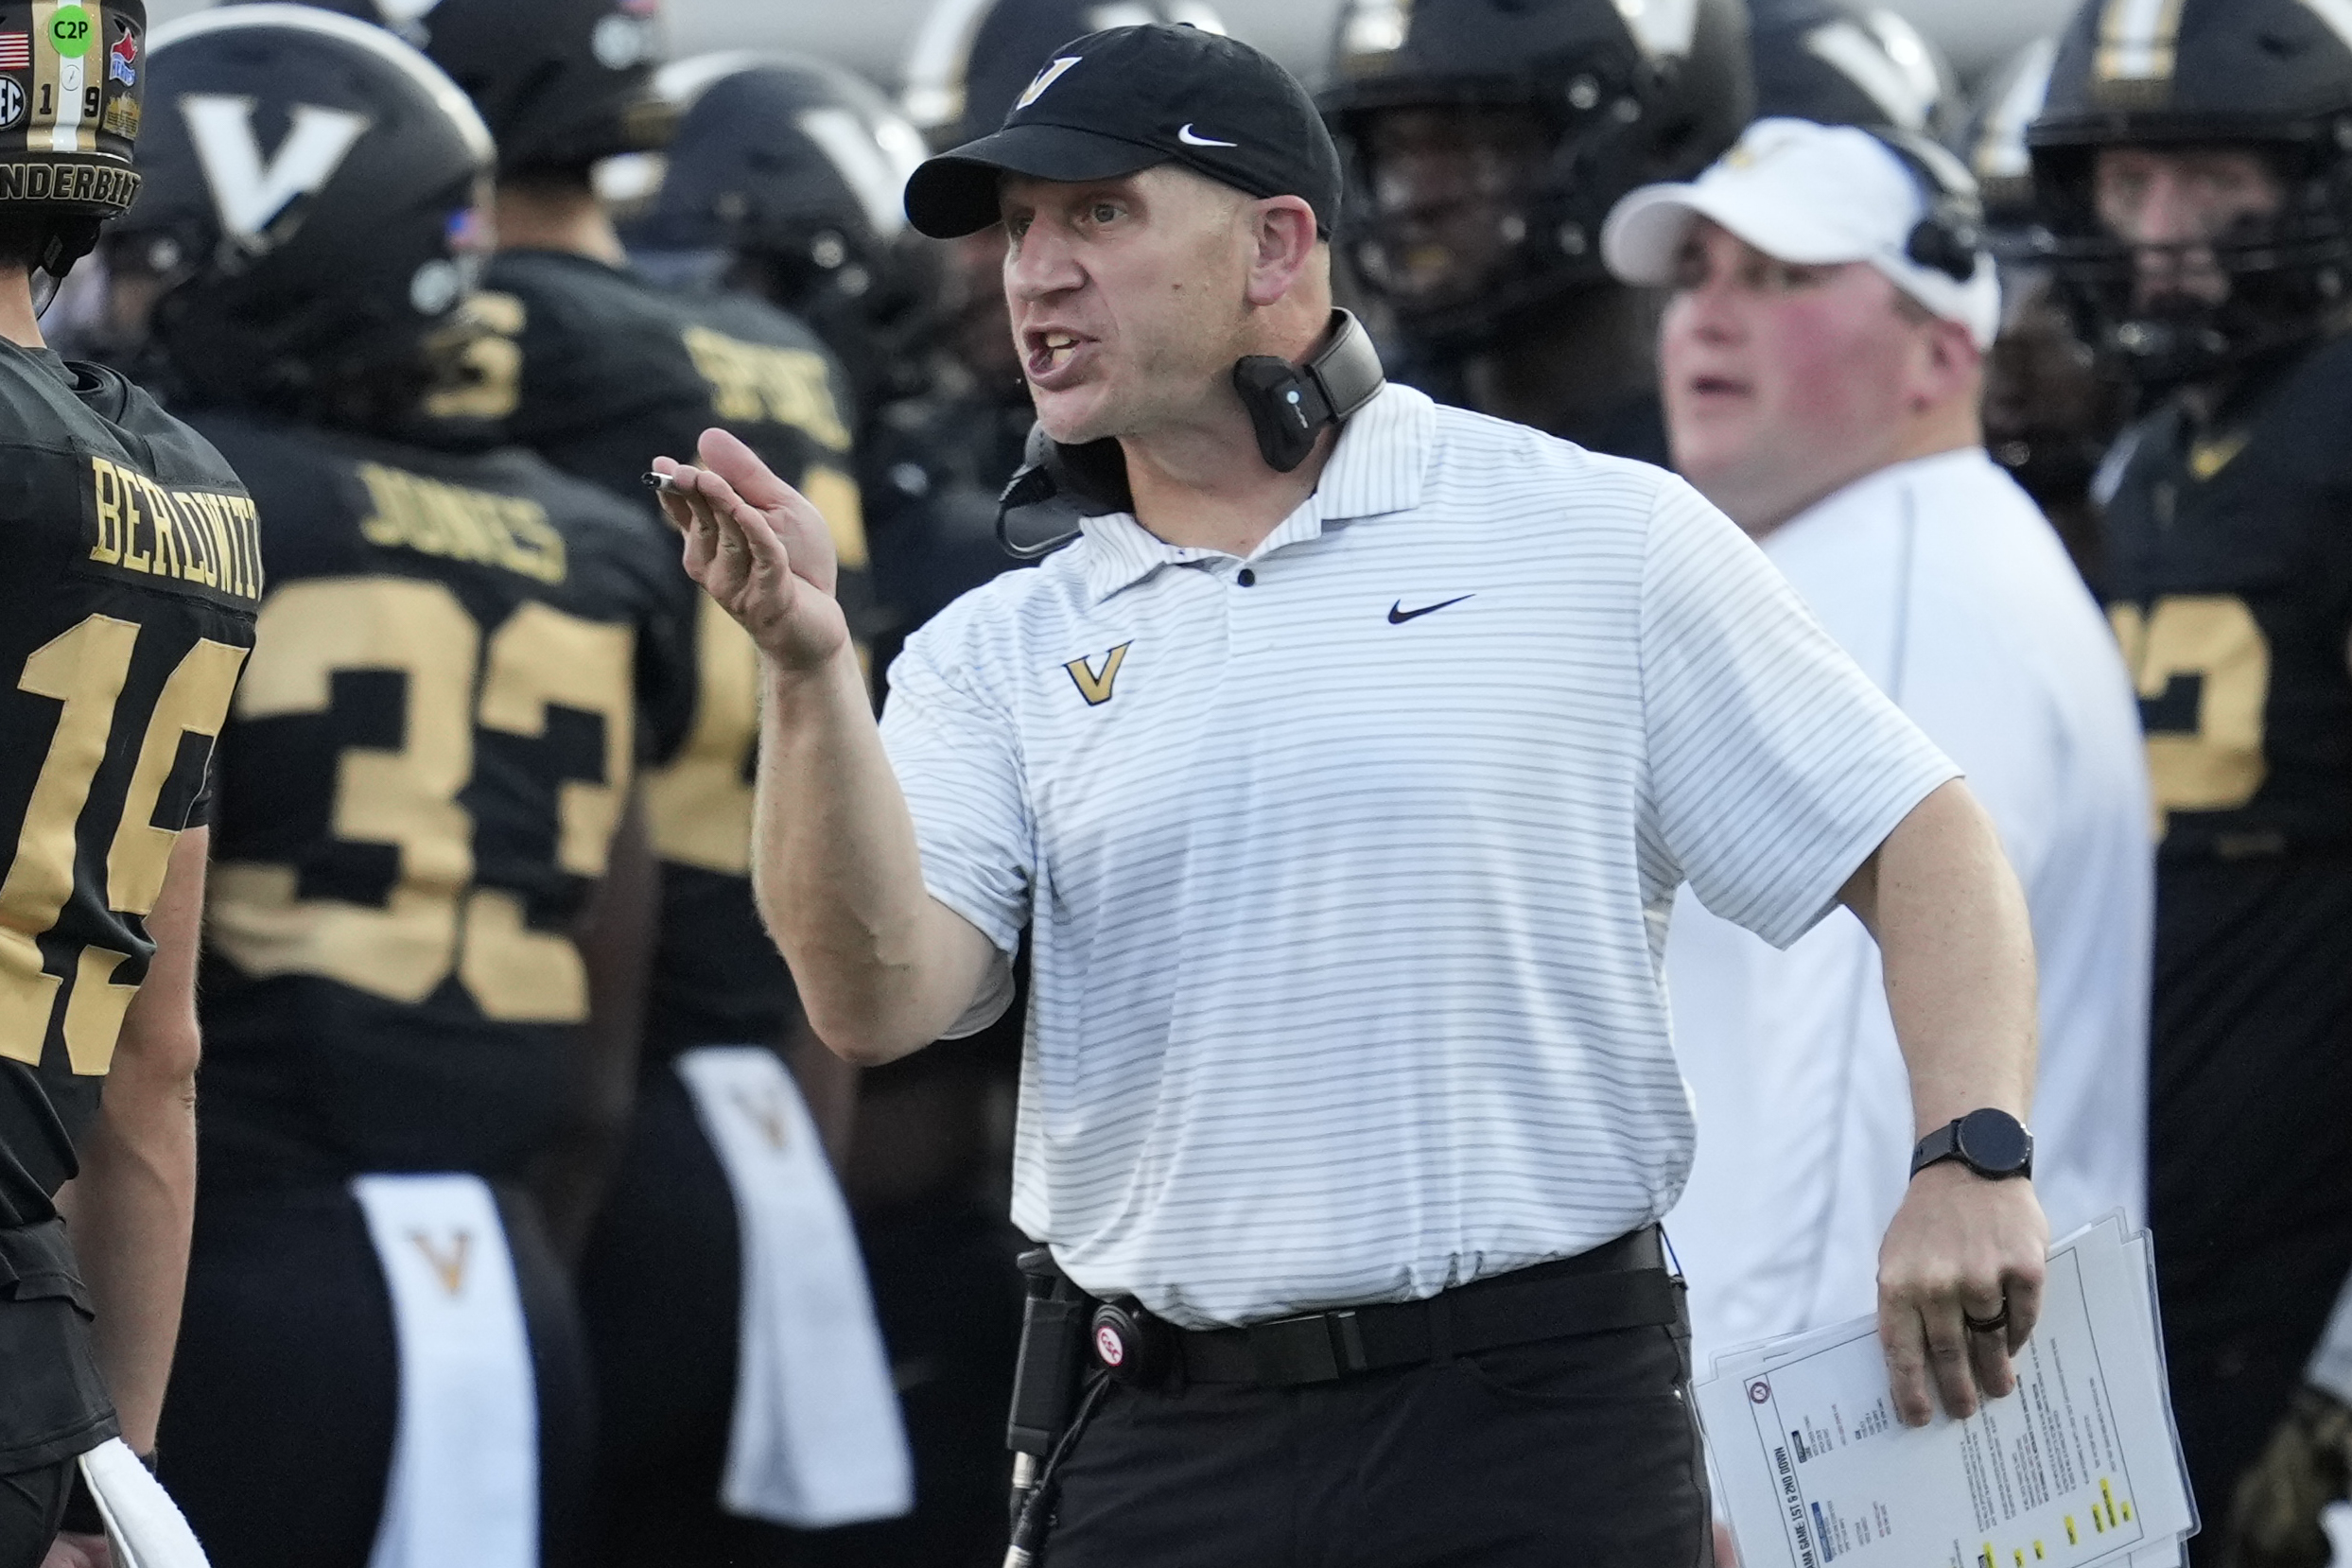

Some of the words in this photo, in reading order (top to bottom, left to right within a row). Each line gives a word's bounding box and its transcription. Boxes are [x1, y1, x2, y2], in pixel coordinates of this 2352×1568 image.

[54, 21, 89, 40] C2P
[1016, 56, 1084, 111] V
[178, 94, 371, 244] V
[1063, 639, 1135, 706] V
[1774, 1446, 1791, 1475] DOWN
[1789, 1504, 1803, 1522] 1ST
